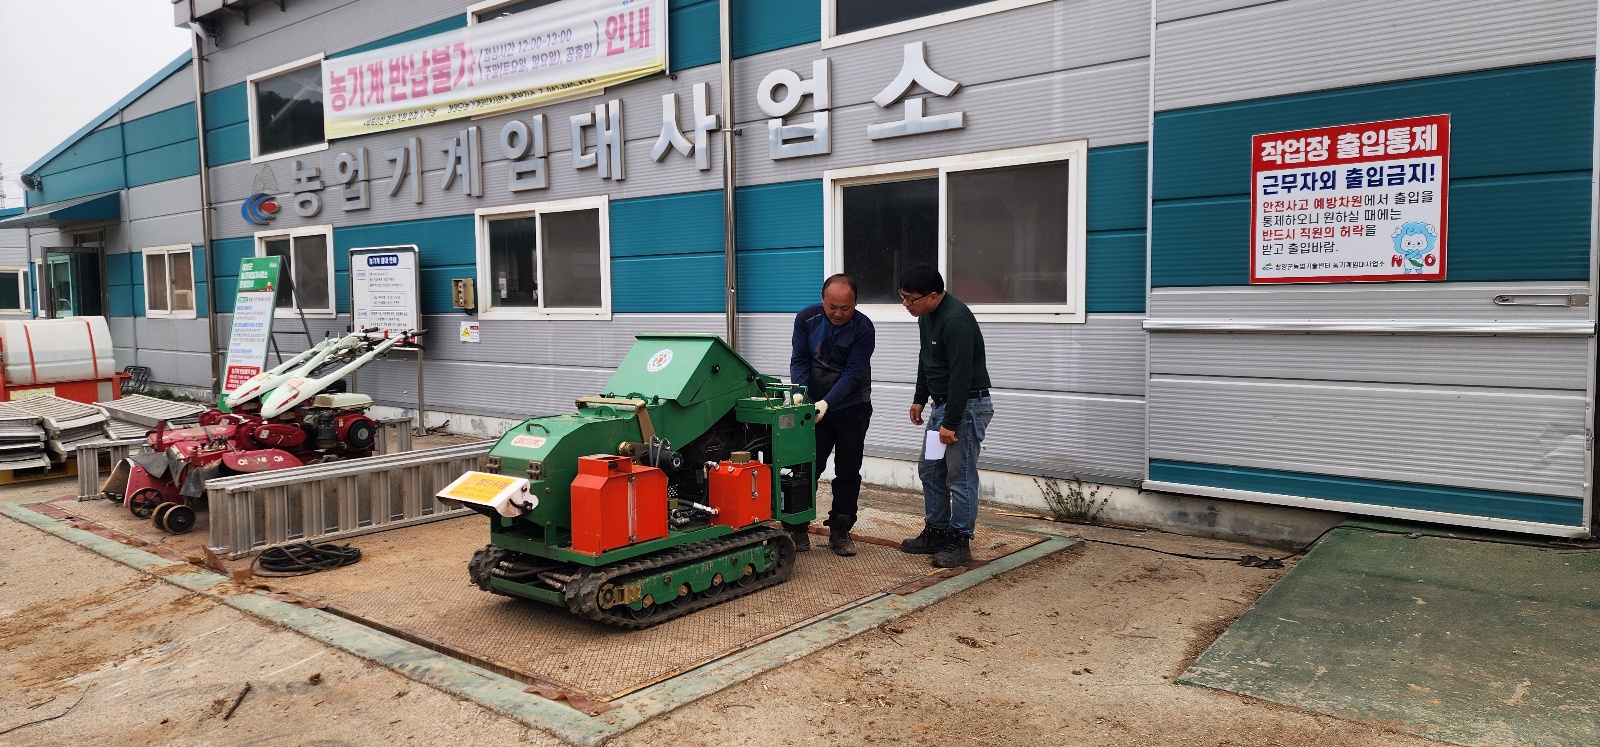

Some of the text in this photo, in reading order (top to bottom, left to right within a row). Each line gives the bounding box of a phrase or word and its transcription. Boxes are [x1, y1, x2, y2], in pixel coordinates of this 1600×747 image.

[330, 6, 650, 112] 농기계 반납불가 안내
[484, 41, 515, 63] 점심시간
[566, 42, 593, 63] 공휴일
[290, 40, 966, 218] 농업기계임대사업소
[1261, 124, 1438, 164] 작업장 출입통제
[1262, 162, 1435, 195] 근무자외 출입금지!
[1262, 190, 1433, 213] 안전사고 예방차원에서 출입을
[1262, 207, 1402, 228] 통제하오니 원하실 때에는
[1262, 224, 1377, 242] 반드시 직원의 허락을
[1262, 241, 1339, 256] 받고 출입바람.
